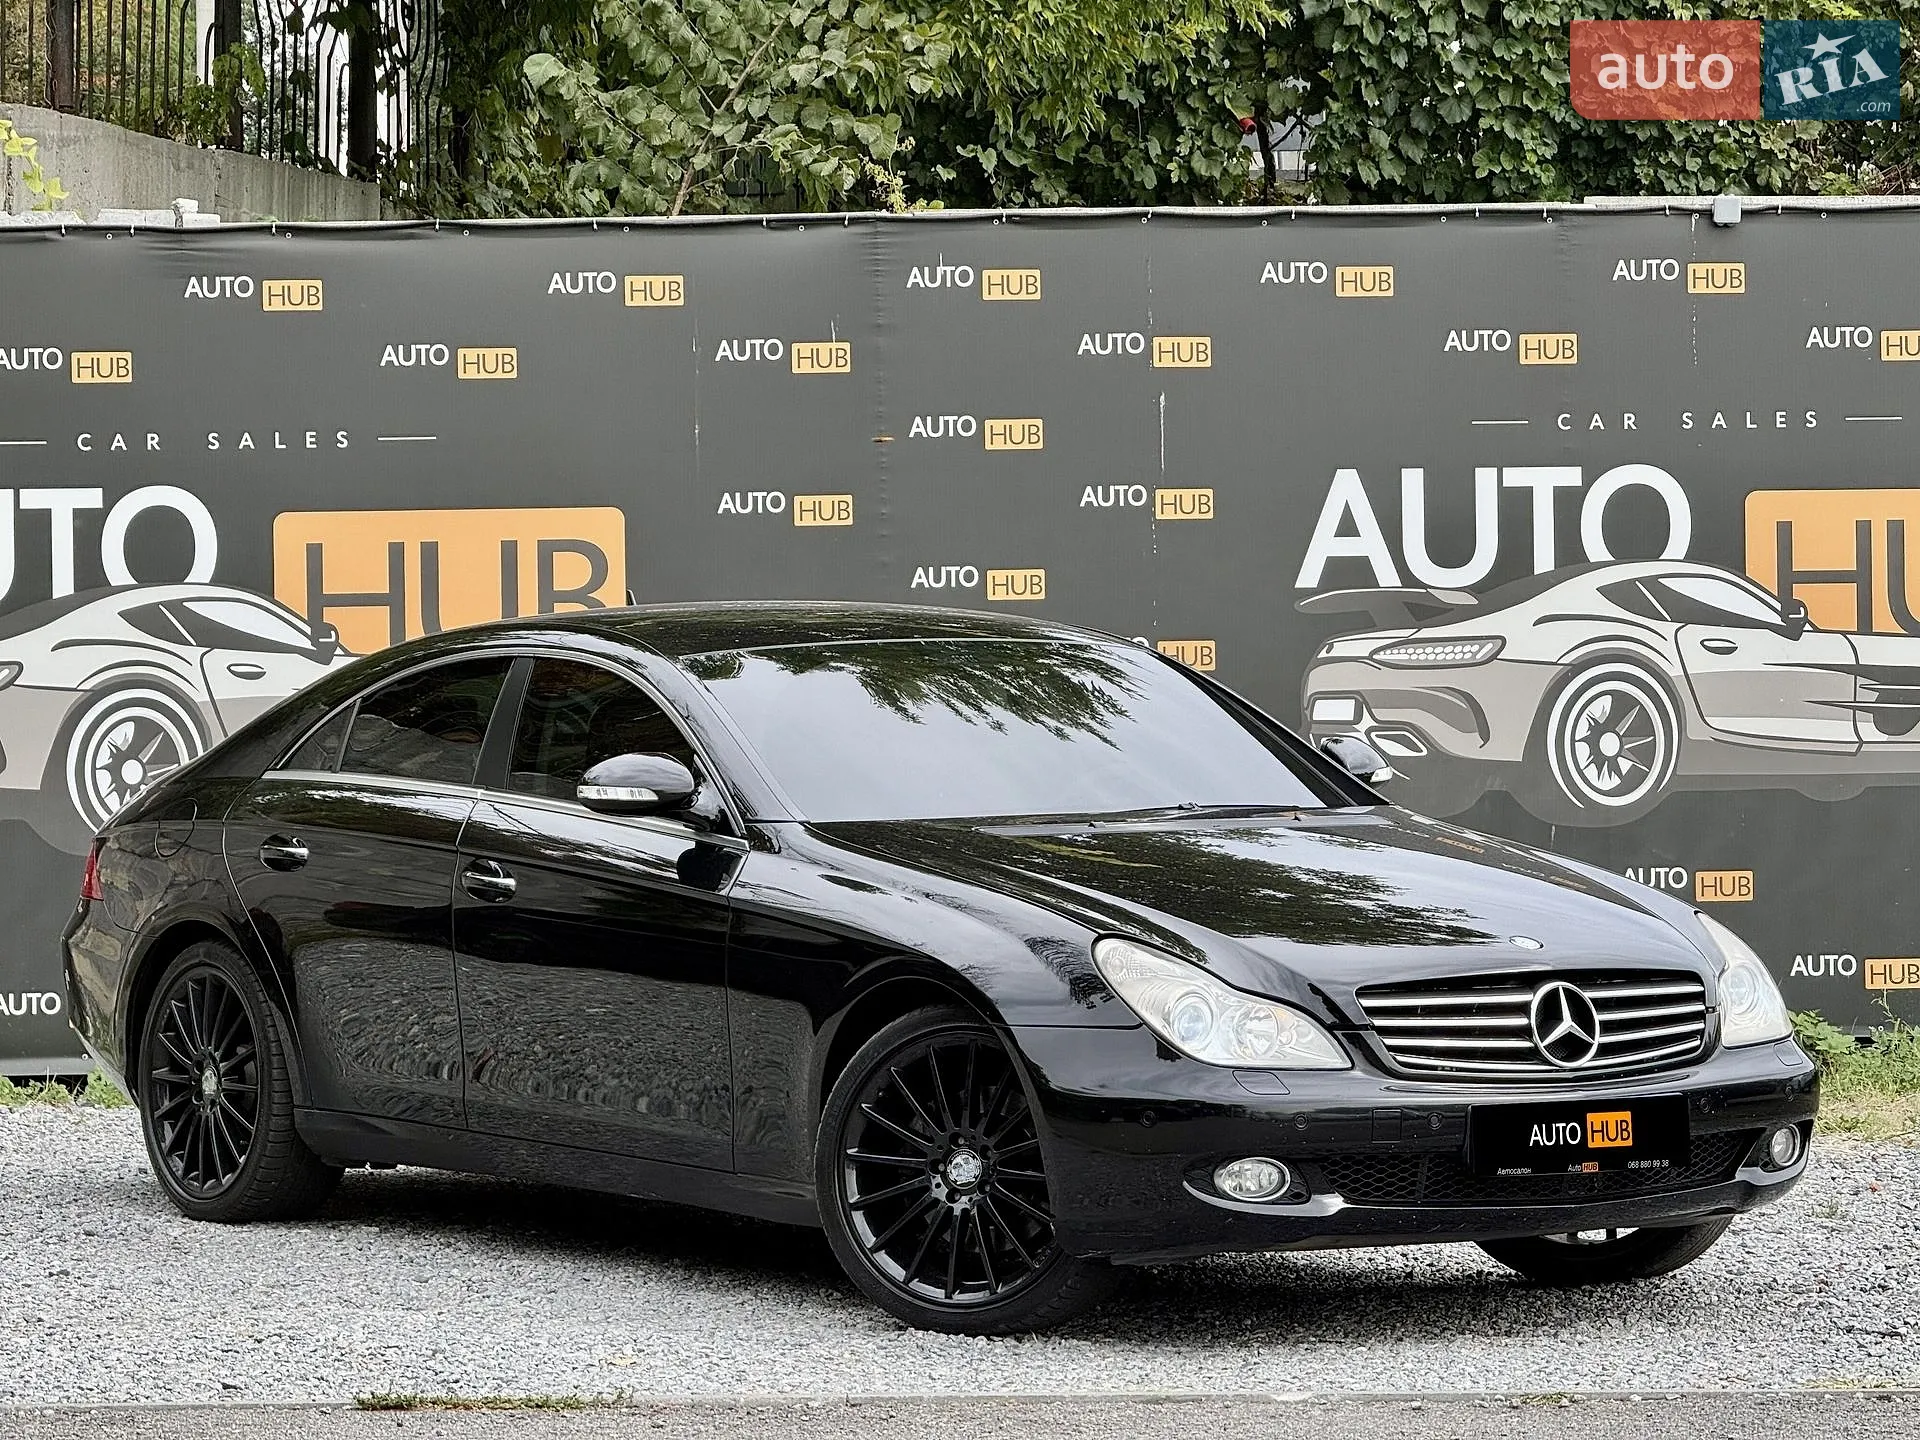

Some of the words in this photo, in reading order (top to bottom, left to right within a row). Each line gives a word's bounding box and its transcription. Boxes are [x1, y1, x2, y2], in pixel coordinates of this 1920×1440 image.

[548, 272, 616, 293] AUTO
[631, 281, 681, 301] HUB
[907, 266, 974, 288] AUTO
[988, 275, 1038, 295] HUB
[1261, 262, 1327, 283] AUTO
[1342, 272, 1391, 292] HUB
[1613, 259, 1679, 280] AUTO
[1693, 269, 1742, 288] HUB
[185, 276, 253, 298] AUTO
[269, 286, 319, 306] HUB
[715, 339, 783, 361] AUTO
[798, 348, 847, 368] HUB
[1078, 333, 1144, 354] AUTO
[1159, 343, 1208, 362] HUB
[1444, 330, 1511, 351] AUTO
[1525, 339, 1574, 359] HUB
[1806, 327, 1872, 348] AUTO
[1887, 336, 1920, 356] HU
[77, 358, 129, 378] HUB
[380, 344, 449, 366] AUTO
[464, 354, 514, 373] HUB
[909, 416, 976, 437] AUTO
[991, 425, 1040, 445] HUB
[1558, 414, 1636, 430] CAR
[1683, 411, 1816, 429] SALES
[78, 434, 160, 451] CAR
[208, 431, 348, 449] SALES
[718, 492, 785, 513] AUTO
[800, 501, 850, 521] HUB
[1080, 485, 1147, 506] AUTO
[1161, 494, 1210, 514] HUB
[1295, 464, 1692, 589] AUTO
[911, 566, 978, 588] AUTO
[993, 575, 1042, 595] HUB
[1702, 876, 1750, 896] HUB
[1791, 955, 1856, 976] AUTO
[1871, 964, 1920, 984] HUB
[1530, 1123, 1581, 1146] AUTO
[1591, 1120, 1630, 1142] HUB
[1567, 1164, 1581, 1172] Auto
[1583, 1163, 1598, 1171] HUB
[1653, 1160, 1660, 1168] 99
